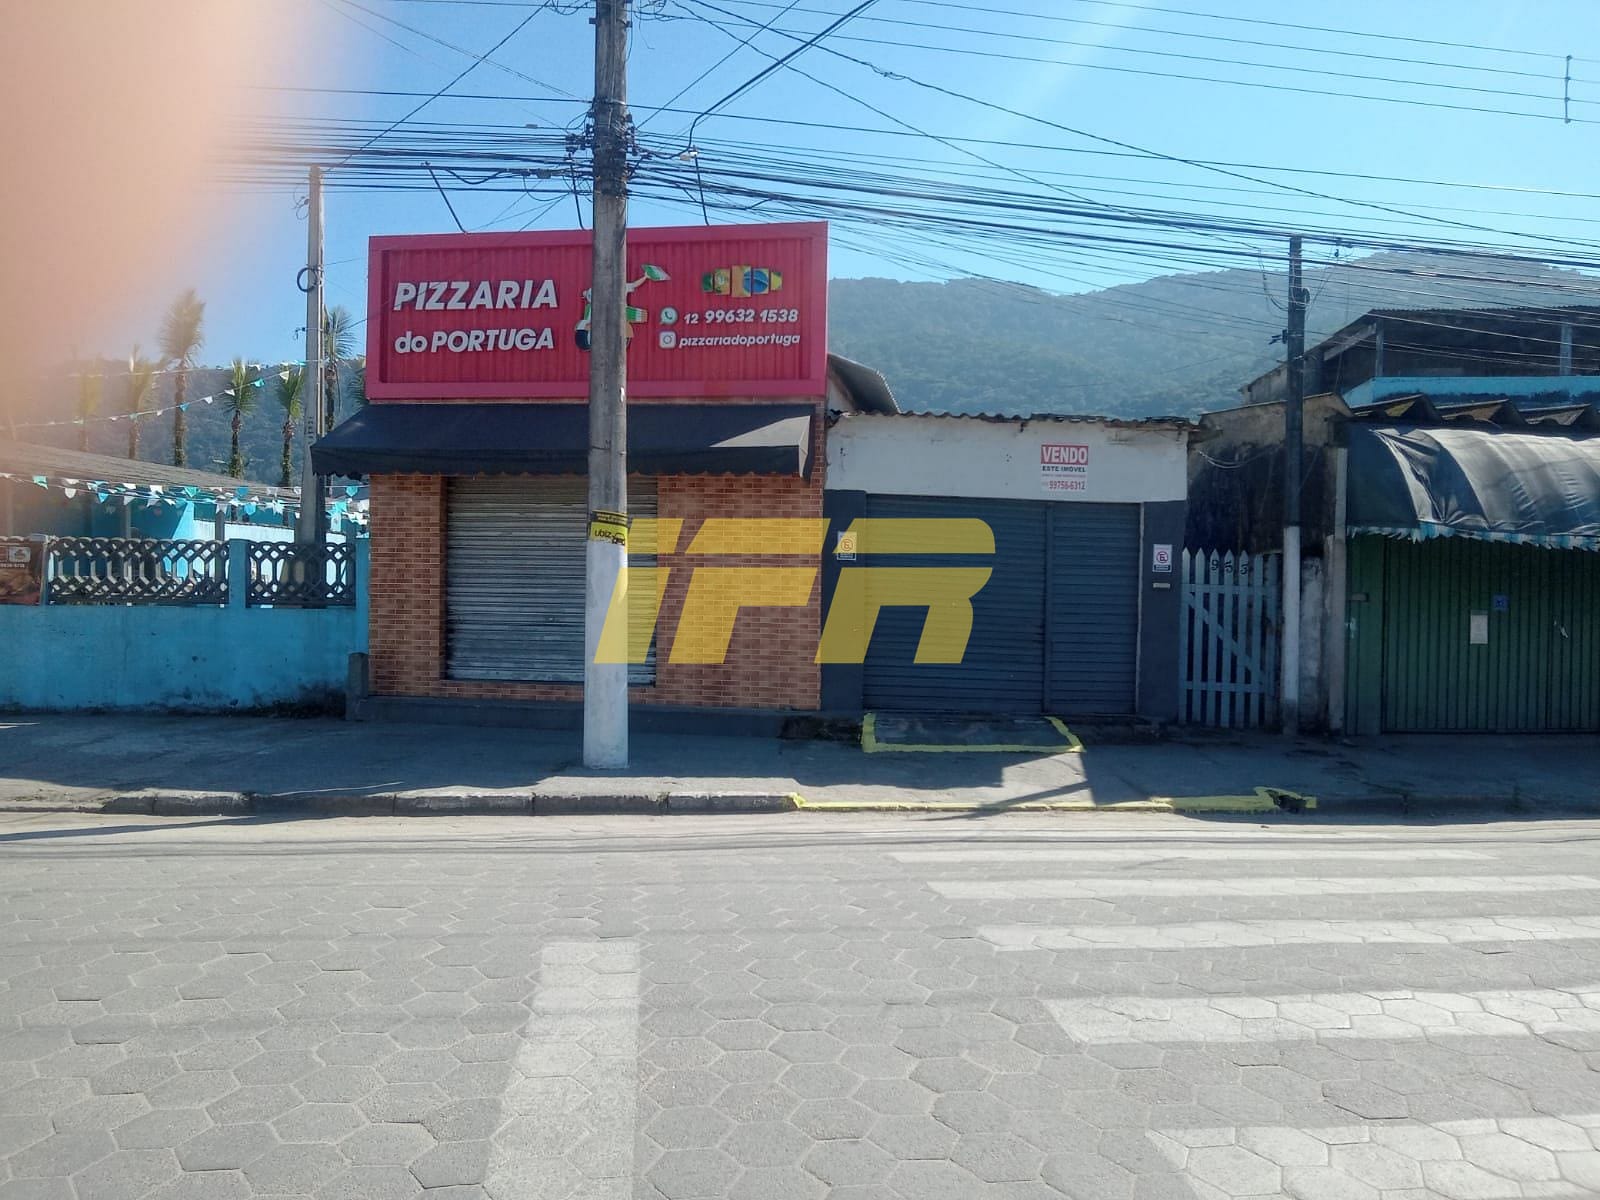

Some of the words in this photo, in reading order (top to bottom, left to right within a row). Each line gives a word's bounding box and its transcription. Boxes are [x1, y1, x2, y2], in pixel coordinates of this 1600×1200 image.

[393, 279, 558, 311] PIZZARIA
[684, 312, 699, 324] 12
[705, 308, 755, 323] 99632
[760, 308, 799, 323] 1538
[394, 331, 428, 353] do
[430, 327, 554, 353] PORTUGA
[679, 332, 801, 349] pizzariadoportuga
[1042, 446, 1088, 464] VENDO
